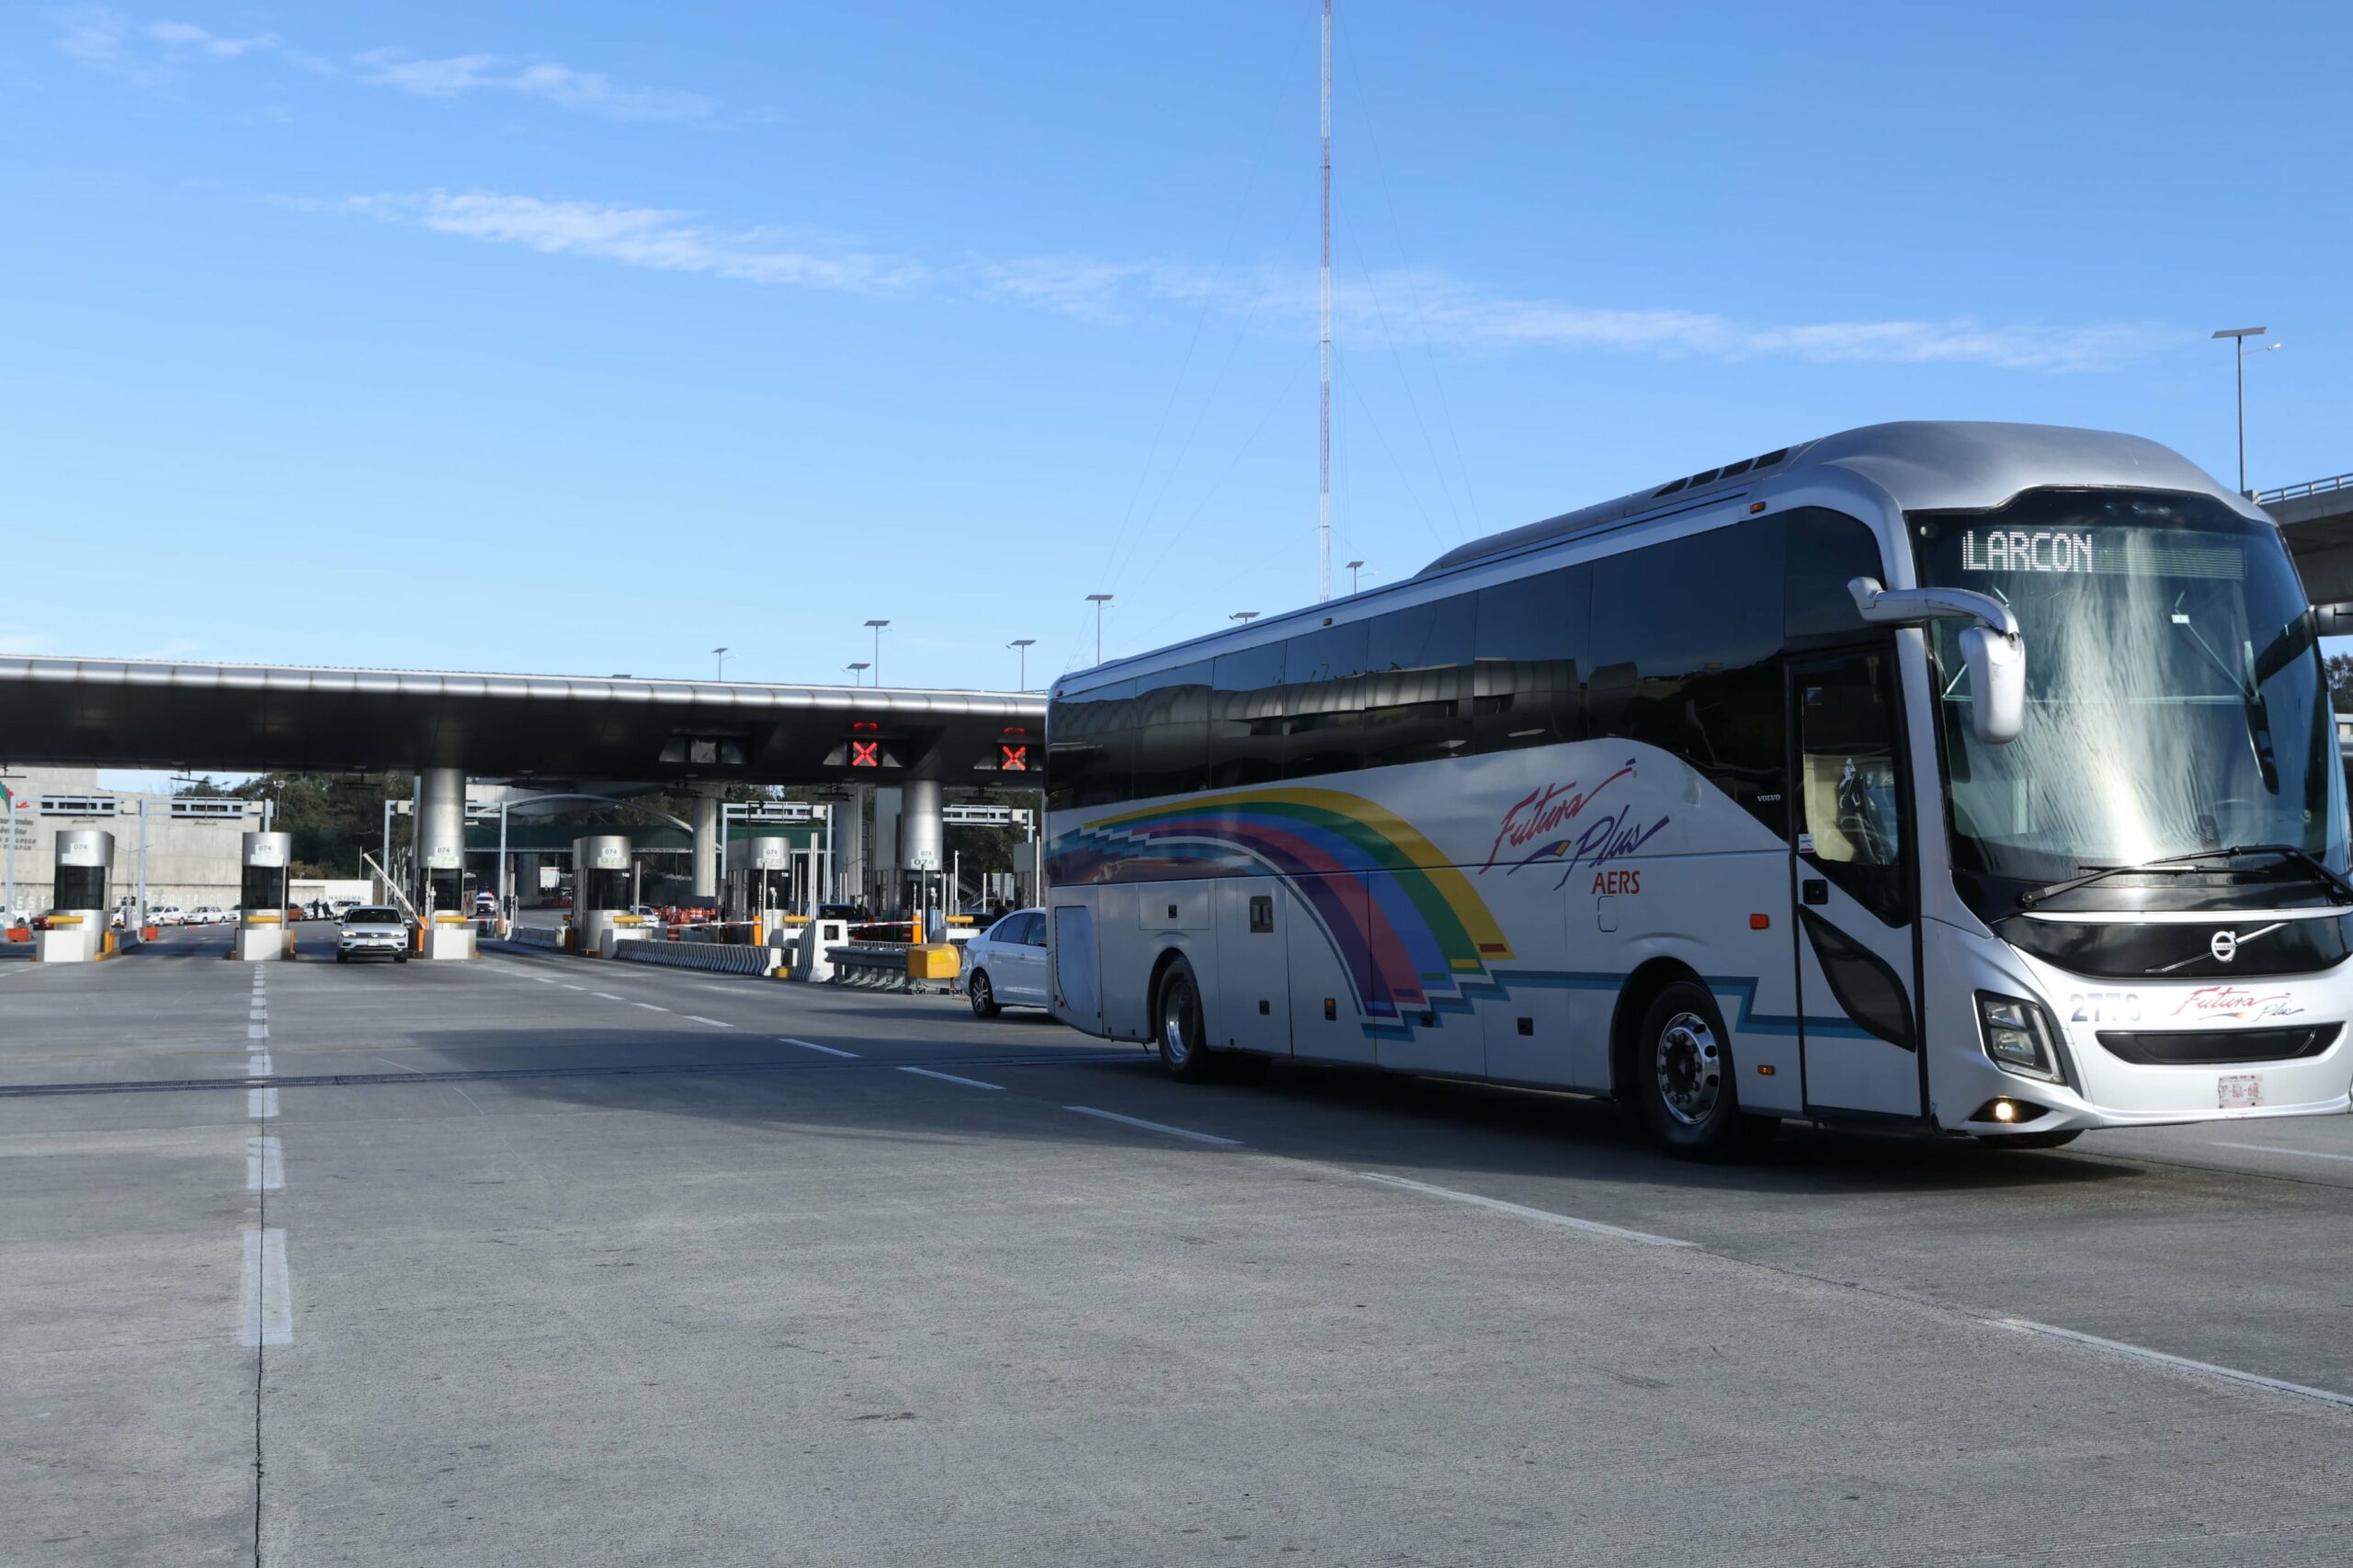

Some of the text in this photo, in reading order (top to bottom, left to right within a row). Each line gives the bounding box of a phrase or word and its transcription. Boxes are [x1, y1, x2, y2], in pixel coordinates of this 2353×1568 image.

[1962, 529, 2093, 573] LARCON
[1756, 793, 1781, 802] VOLVO
[1478, 767, 1632, 875] Futura
[1553, 804, 1670, 892] Plus
[1591, 869, 1642, 895] AERS
[2169, 986, 2290, 1016] Futura
[2252, 1002, 2305, 1022] Plus
